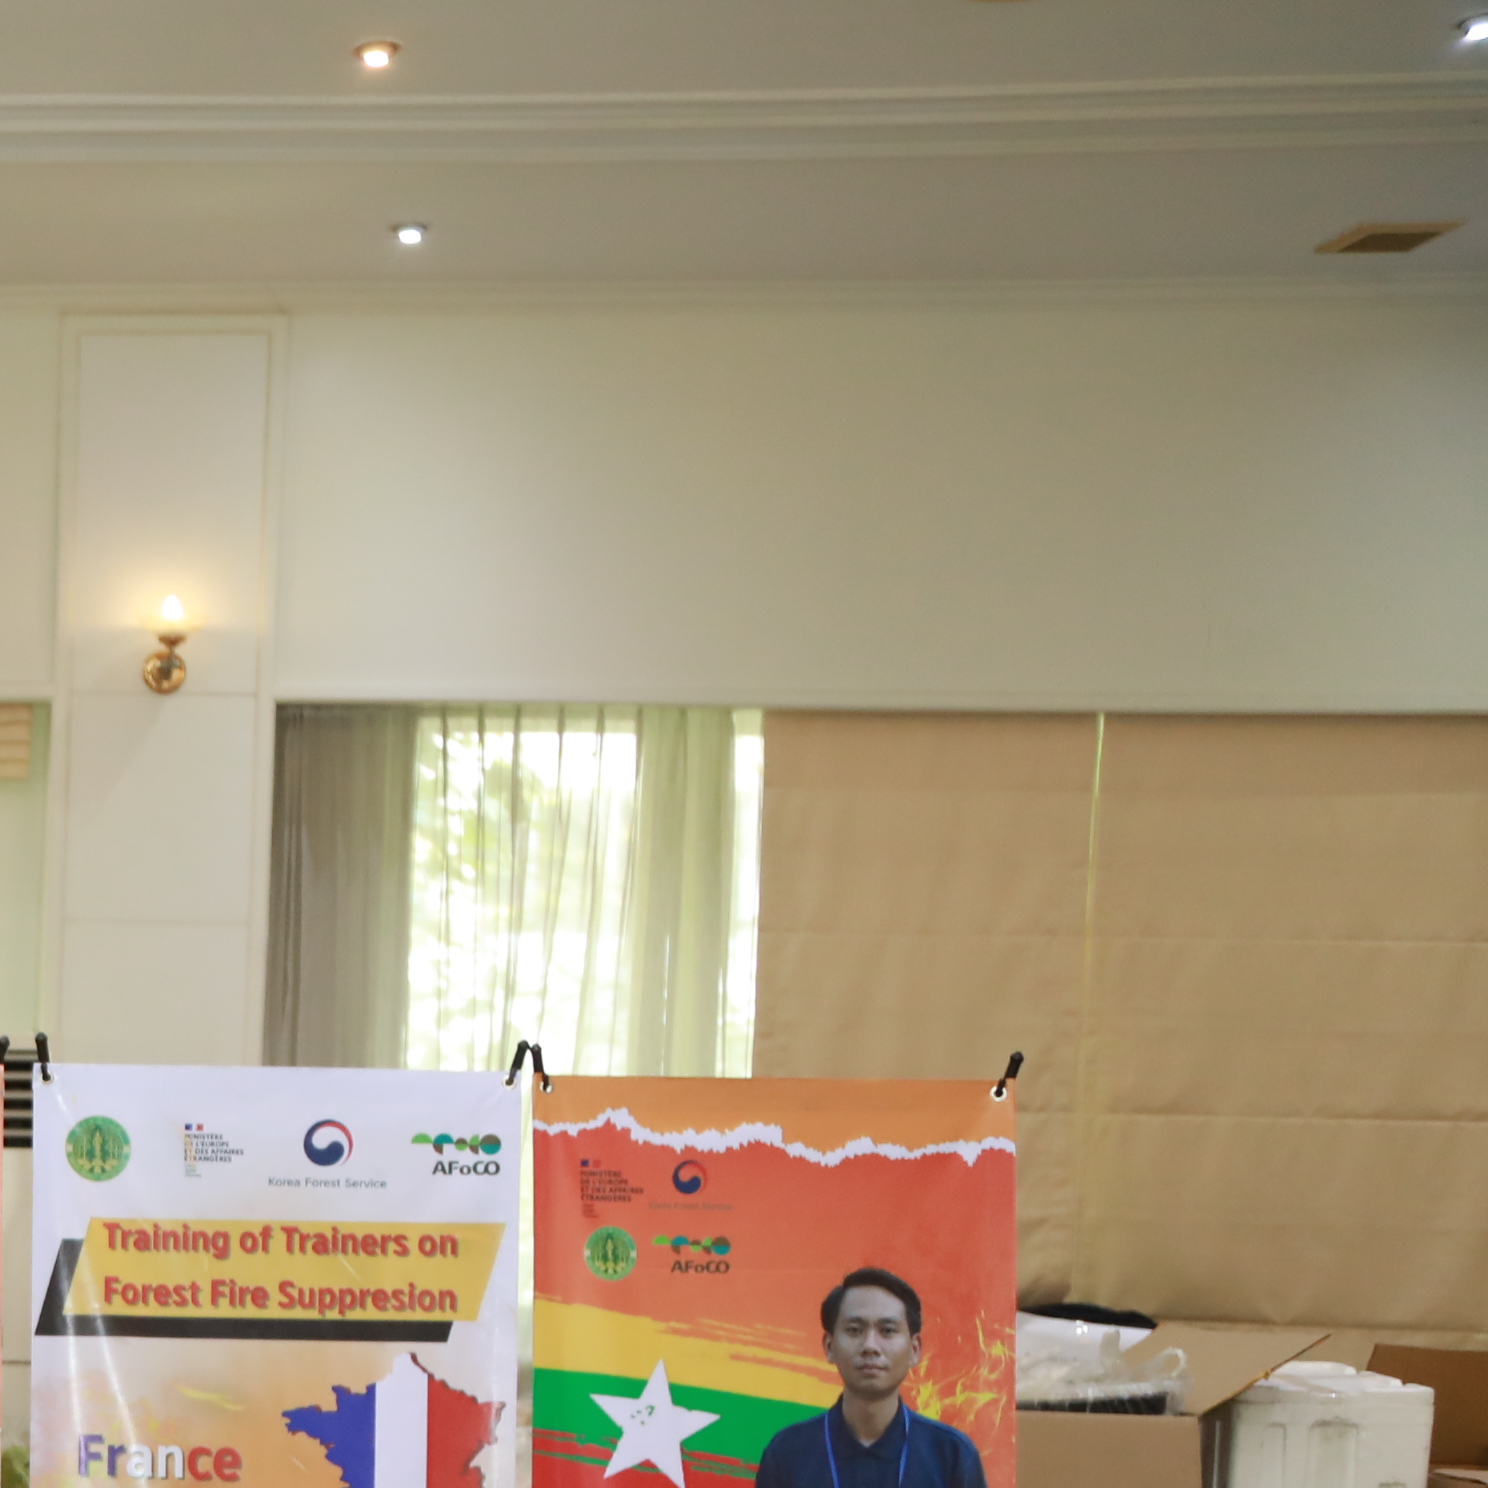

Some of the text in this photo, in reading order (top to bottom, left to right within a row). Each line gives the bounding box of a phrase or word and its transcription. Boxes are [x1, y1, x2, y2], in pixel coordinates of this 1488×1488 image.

[432, 1161, 501, 1176] AFoCO
[268, 1177, 388, 1189] Korea Forest Service
[102, 1222, 459, 1261] Training of Trainers on
[671, 1259, 730, 1274] AFoCO
[103, 1275, 458, 1318] Forest Fire Suppresion
[77, 1434, 243, 1481] France
